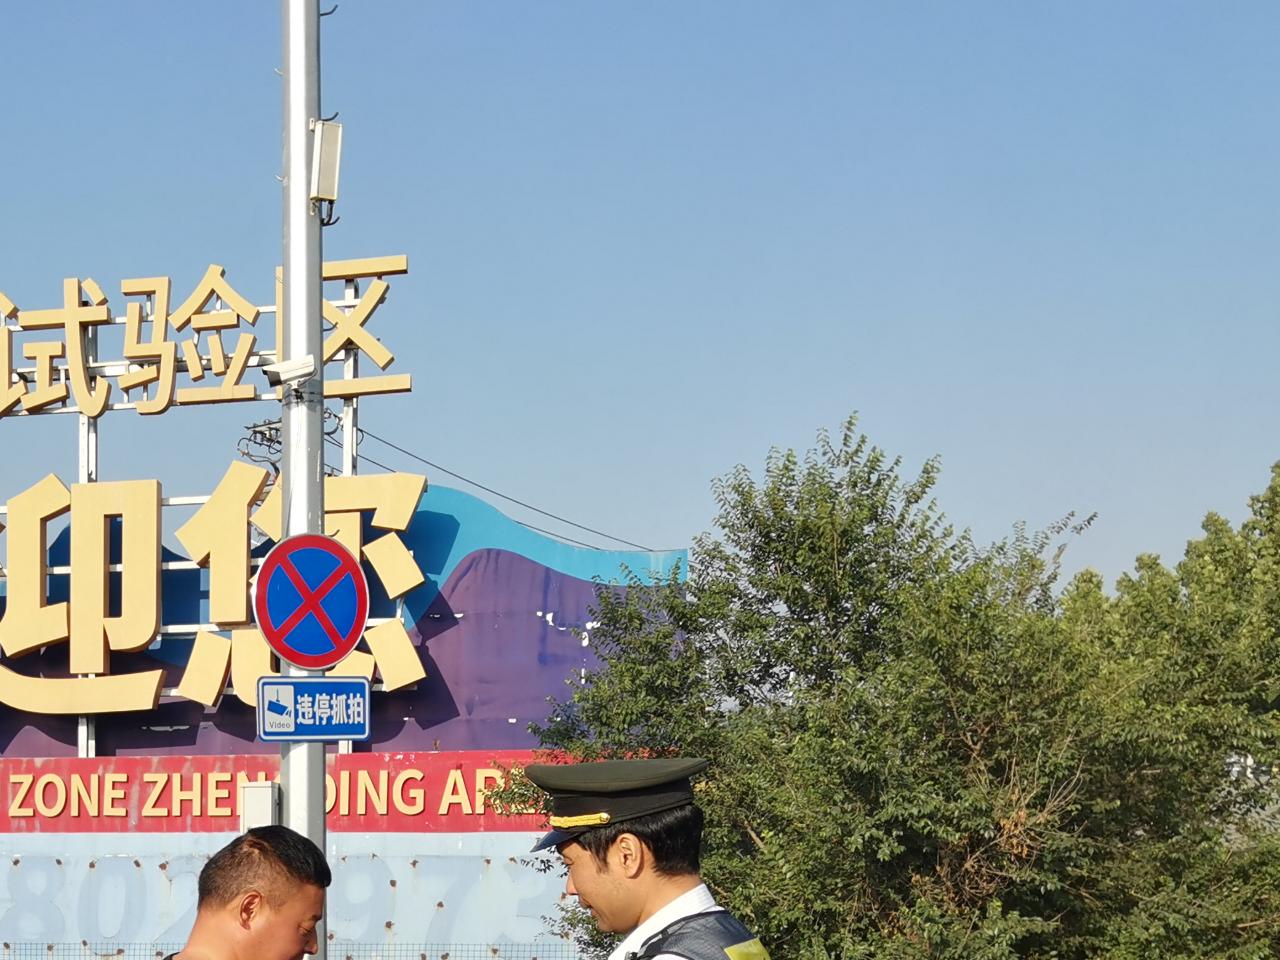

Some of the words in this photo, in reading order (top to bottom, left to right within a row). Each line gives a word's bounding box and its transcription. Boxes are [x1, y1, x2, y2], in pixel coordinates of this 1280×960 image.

[269, 721, 291, 729] Video
[296, 692, 364, 726] 违停抓拍
[8, 772, 128, 818] ZONE
[142, 769, 424, 818] ZHEING
